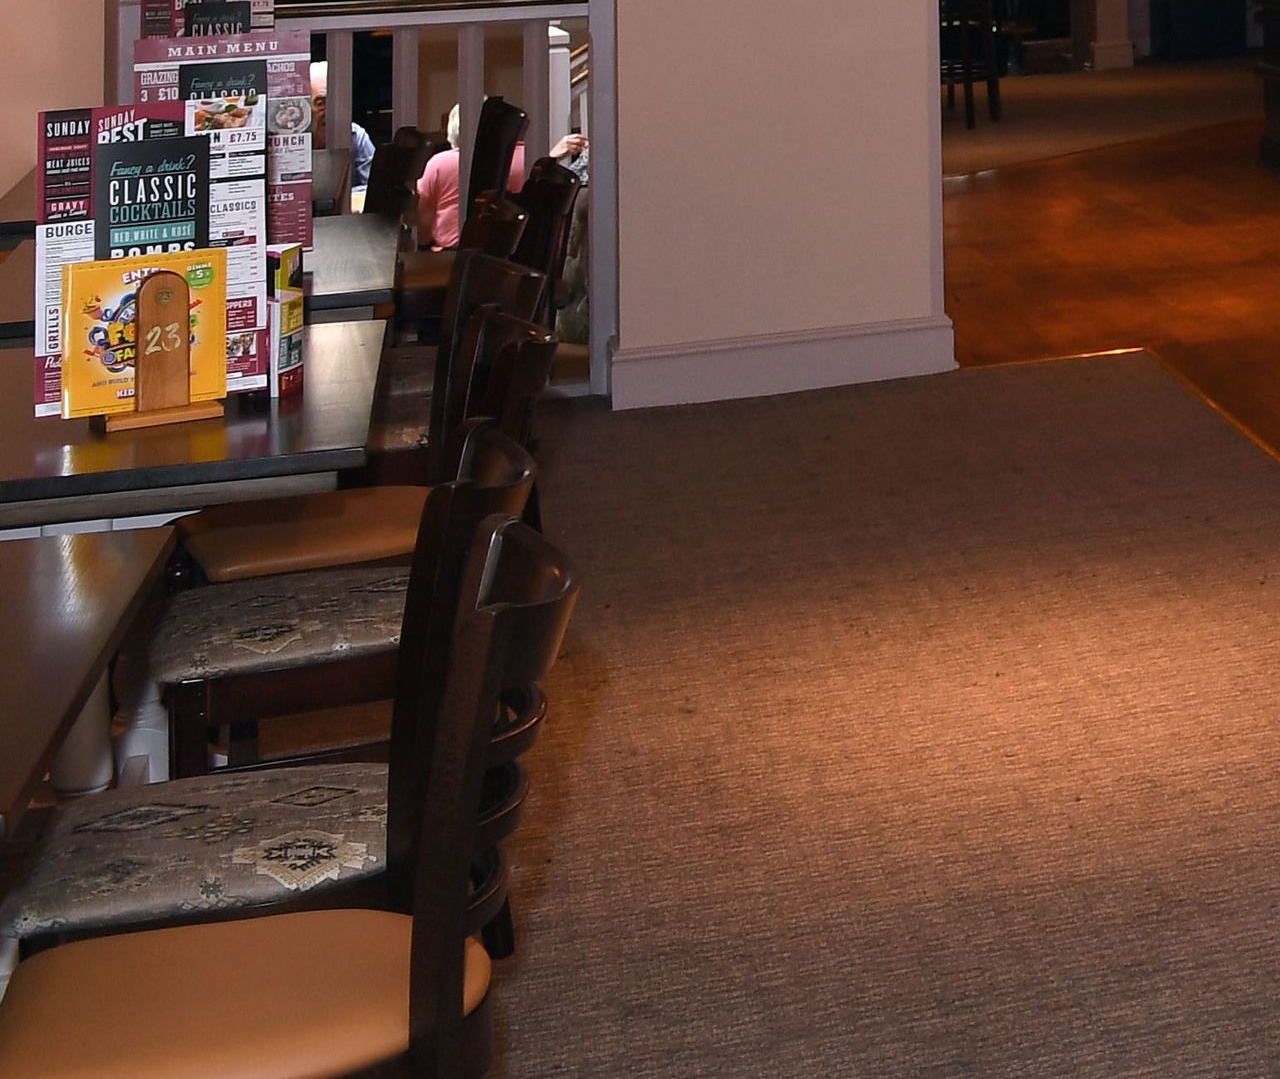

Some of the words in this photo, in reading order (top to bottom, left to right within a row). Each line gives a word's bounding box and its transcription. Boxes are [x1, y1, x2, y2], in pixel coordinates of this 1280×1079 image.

[191, 22, 243, 38] CLASSIC
[167, 44, 218, 58] MAIN
[226, 40, 279, 54] MENU
[140, 69, 179, 85] GRAZING
[140, 89, 149, 102] 3
[158, 86, 179, 101] £10
[46, 120, 91, 138] SUNDAY
[98, 108, 136, 133] SUNDAY
[97, 117, 148, 144] BEST
[229, 131, 257, 143] £7.75
[110, 160, 143, 178] Fancy
[157, 153, 196, 174] drink?
[109, 172, 197, 207] CLASSIC
[51, 200, 85, 212] GRAVY
[109, 199, 196, 224] COCKTAILS
[210, 200, 257, 214] CLASSICS
[45, 222, 93, 238] BURGE
[48, 307, 59, 350] GRILLS
[145, 322, 182, 356] 23
